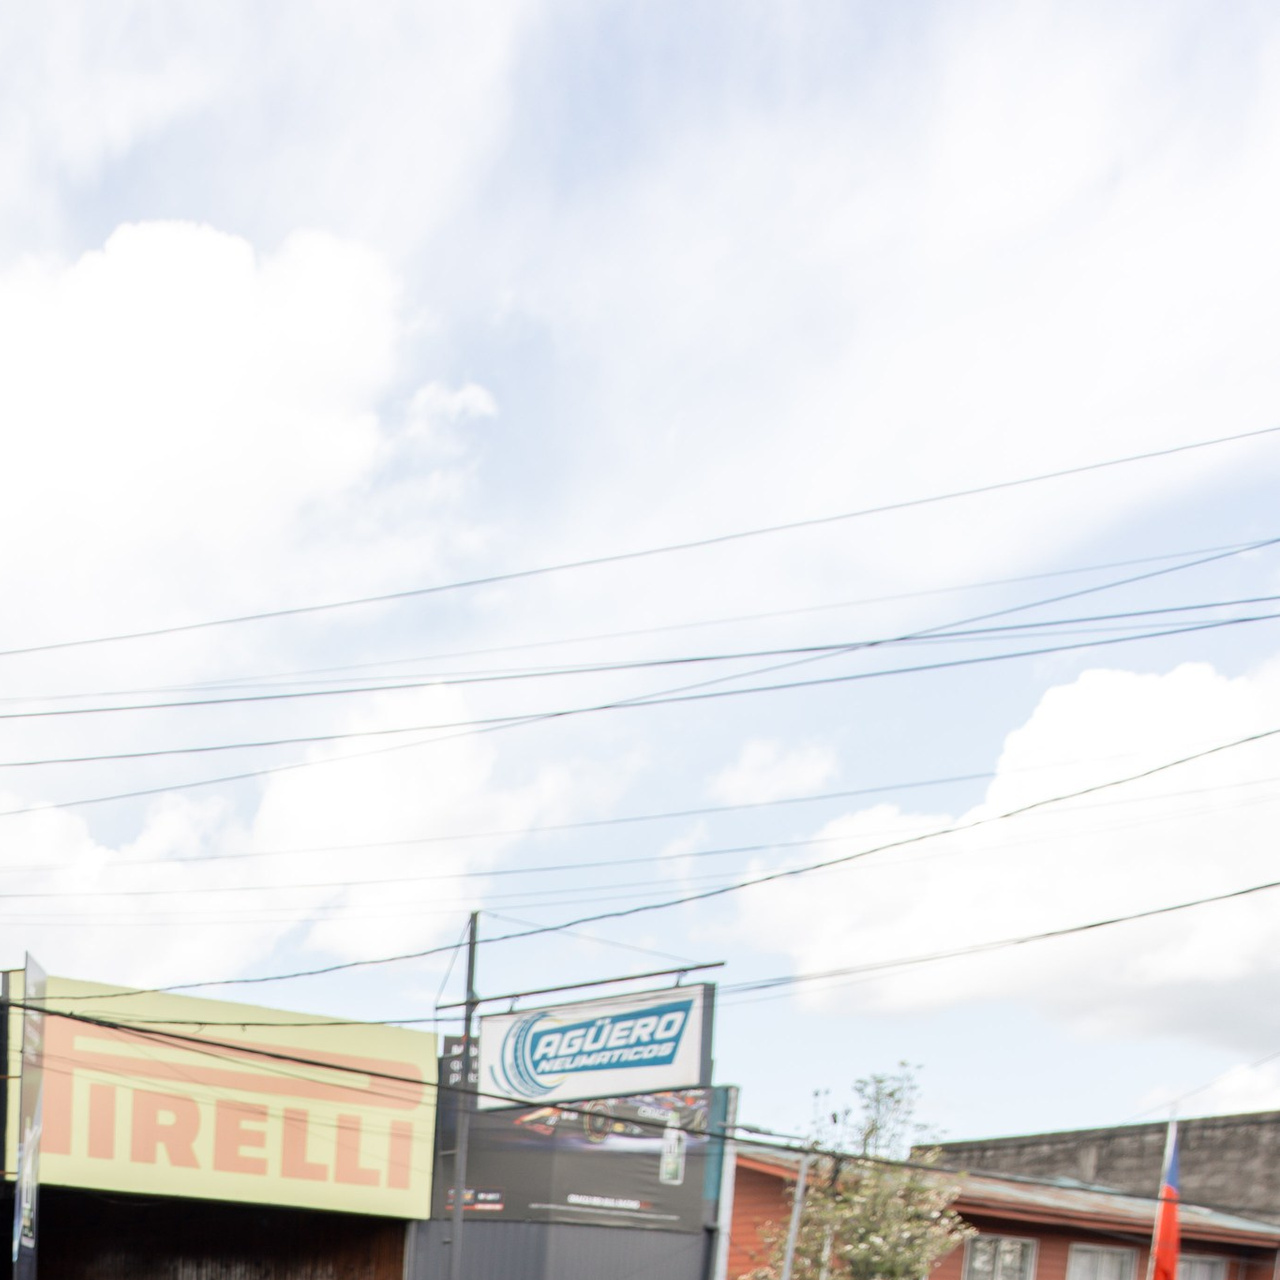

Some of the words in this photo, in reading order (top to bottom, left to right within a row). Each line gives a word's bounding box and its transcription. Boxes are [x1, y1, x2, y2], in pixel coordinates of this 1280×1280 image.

[532, 1010, 687, 1061] AGÜERO
[536, 1041, 676, 1074] NEUMATICOS
[40, 1011, 426, 1190] PIRELLI
